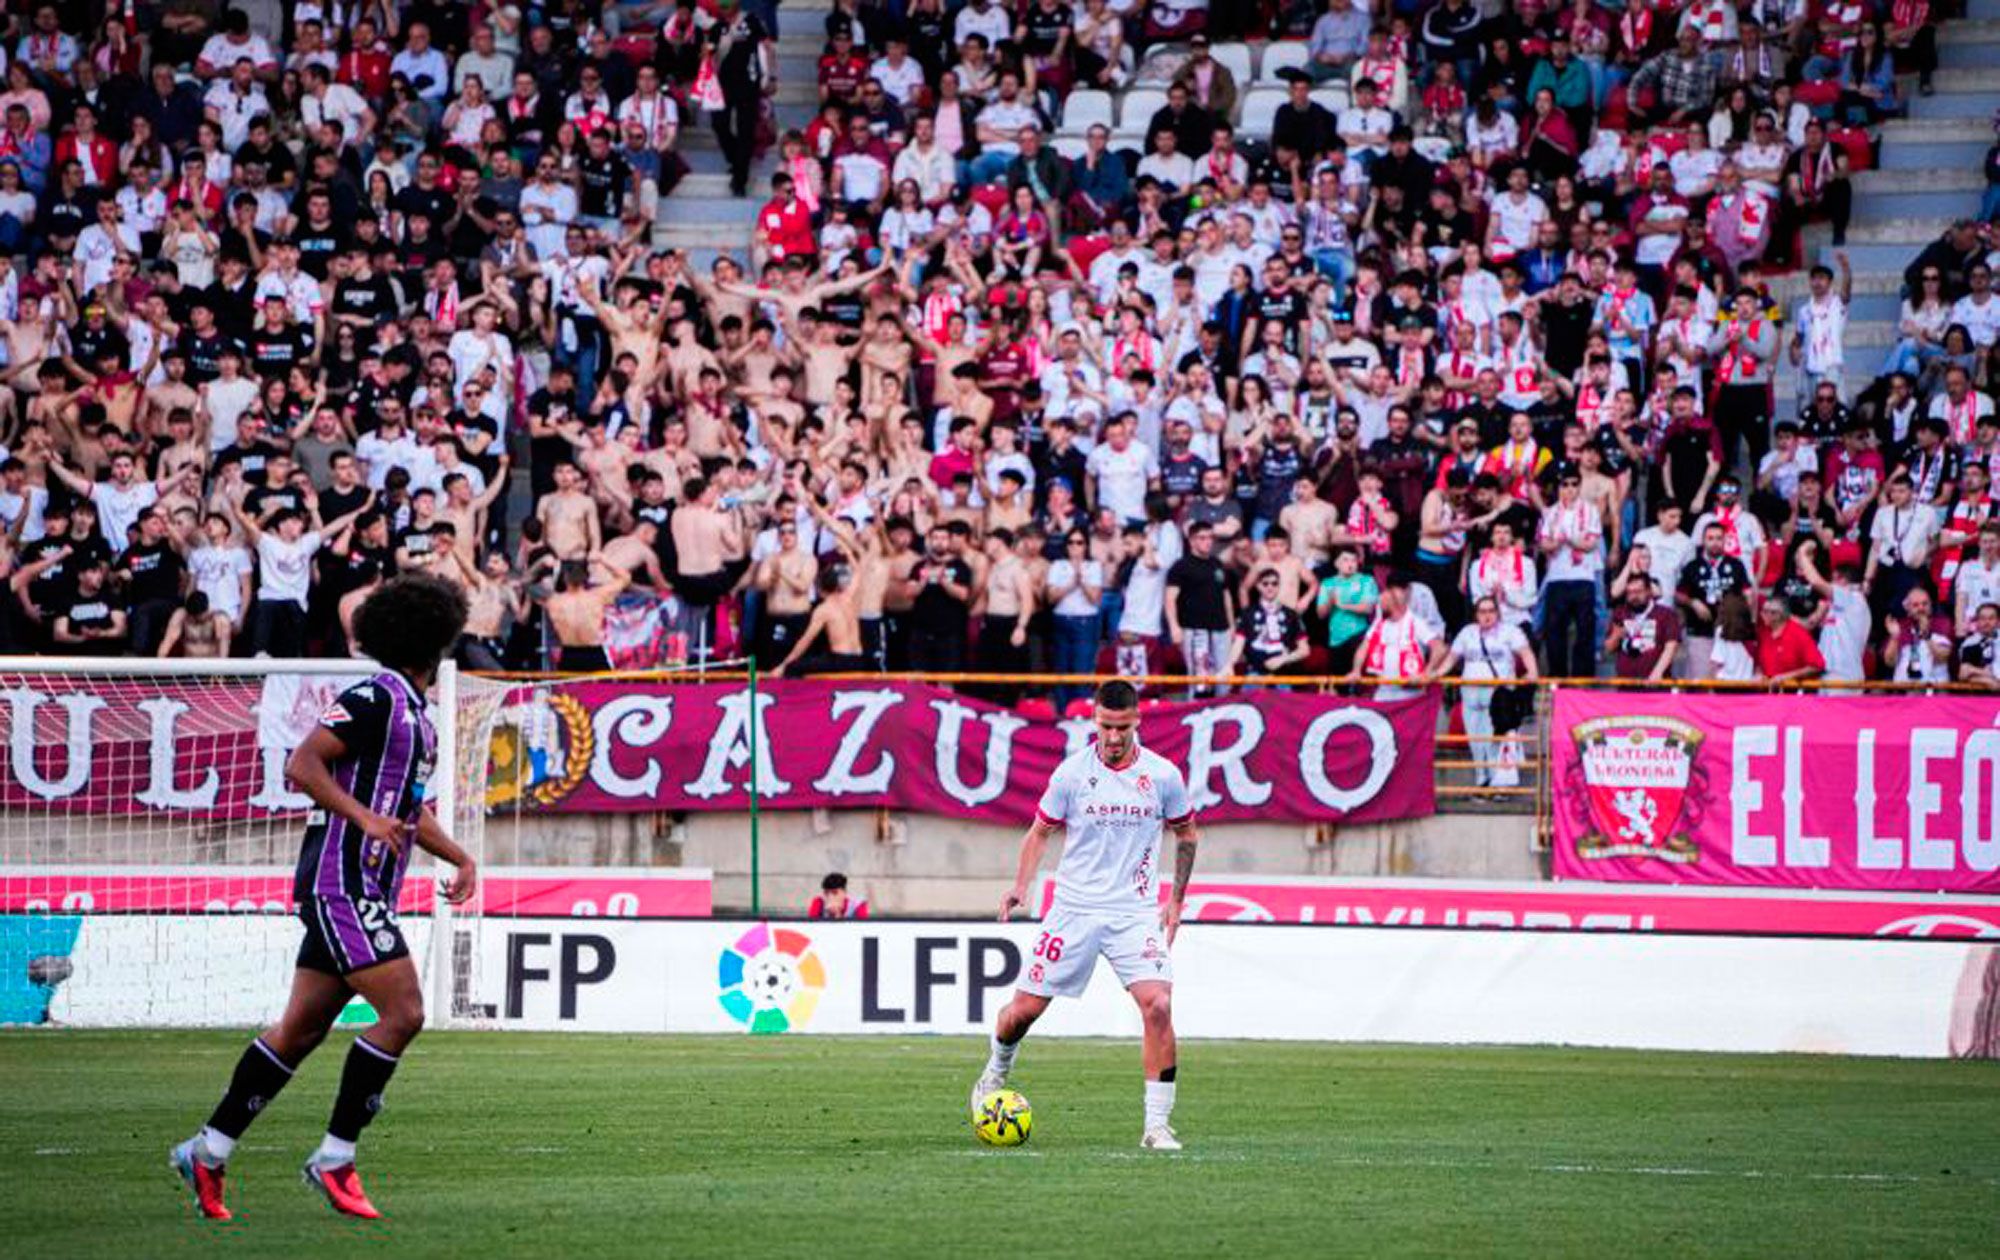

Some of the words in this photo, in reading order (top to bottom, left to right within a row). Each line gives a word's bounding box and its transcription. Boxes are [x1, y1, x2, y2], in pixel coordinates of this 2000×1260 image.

[591, 689, 1398, 812] CAZURO
[1729, 725, 1830, 868] EL
[452, 931, 616, 1020] LFP
[862, 936, 1022, 1023] LFP
[1033, 931, 1064, 962] 36
